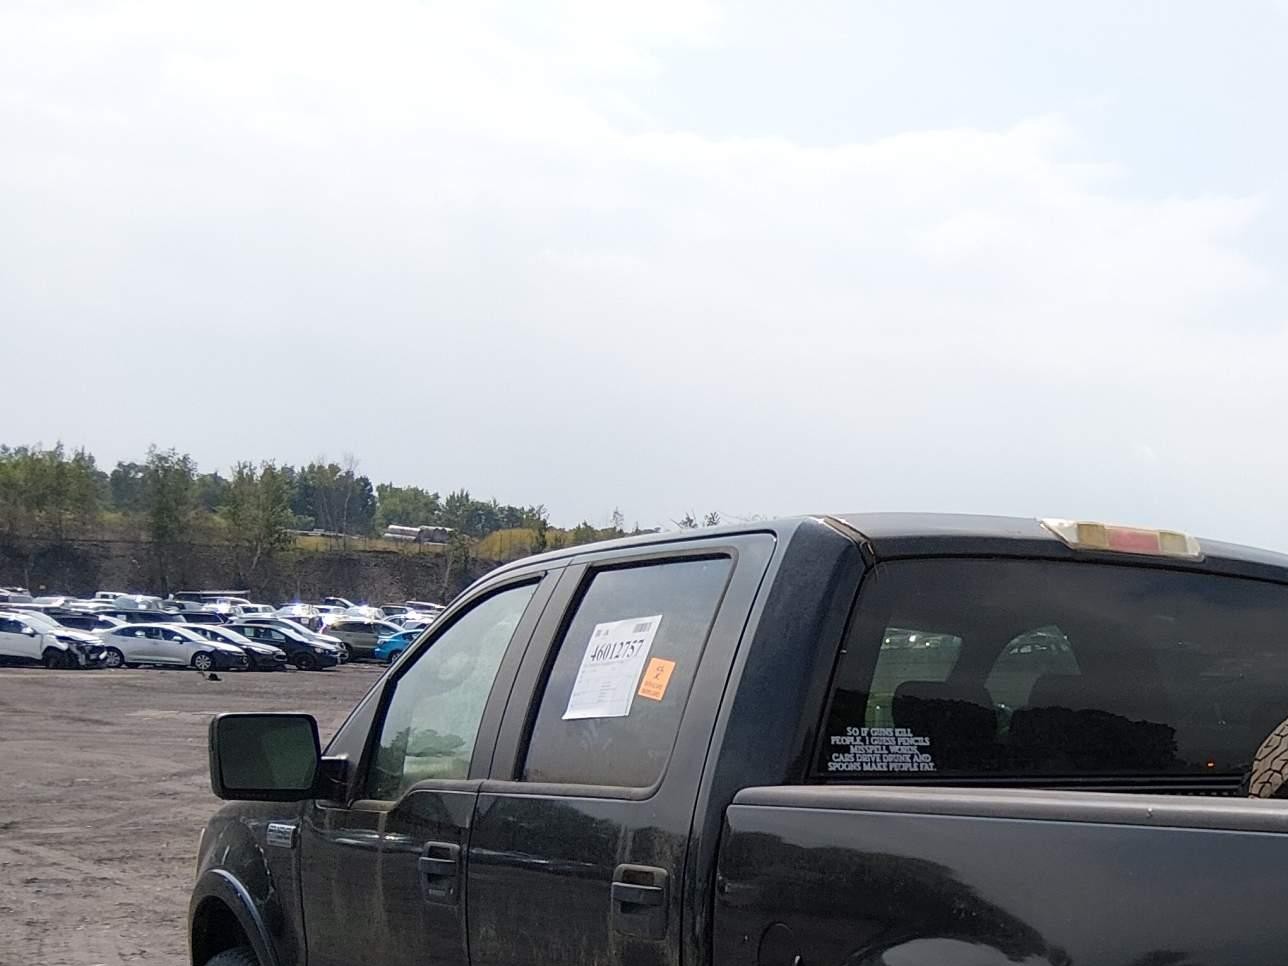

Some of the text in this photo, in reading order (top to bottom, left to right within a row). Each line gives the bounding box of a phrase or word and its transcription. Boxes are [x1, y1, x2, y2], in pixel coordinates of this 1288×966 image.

[590, 639, 645, 661] 46012757
[846, 727, 913, 737] SO IF GUNS KILL
[870, 737, 896, 746] GUESS
[897, 737, 930, 746] PENCILS
[850, 745, 888, 754] MISSPELL
[832, 753, 931, 762] CARS DRIVE DRUNK AND
[828, 762, 861, 771] SPOONS
[863, 762, 888, 771] MAKE
[889, 762, 918, 771] PEOPLE
